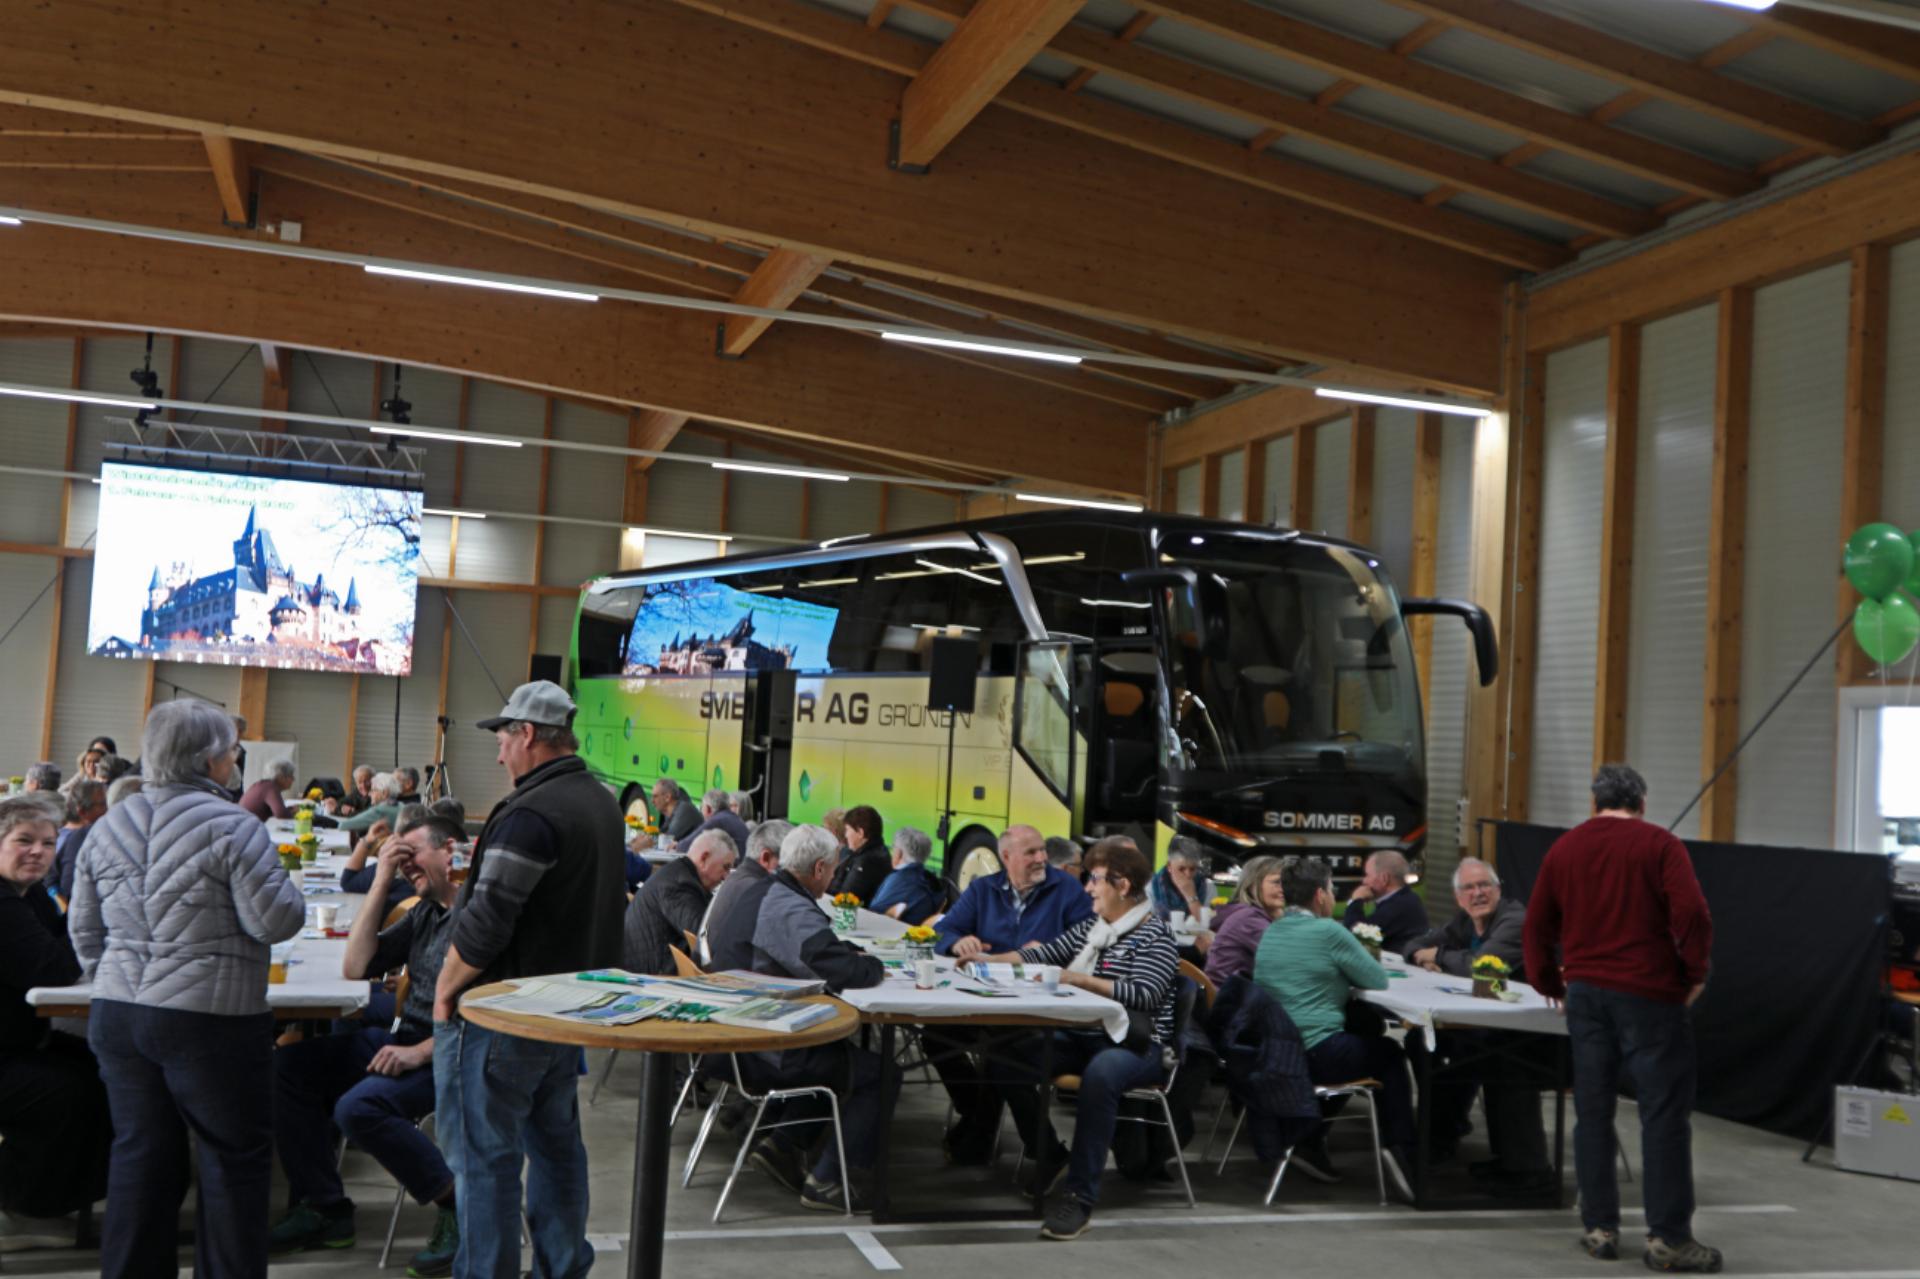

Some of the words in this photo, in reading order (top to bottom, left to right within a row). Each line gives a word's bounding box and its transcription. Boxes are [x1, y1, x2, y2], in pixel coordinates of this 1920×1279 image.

[825, 692, 870, 725] AG
[878, 703, 972, 729] GRÜNEN
[1264, 811, 1363, 830] SOMMER
[1368, 814, 1396, 831] AG
